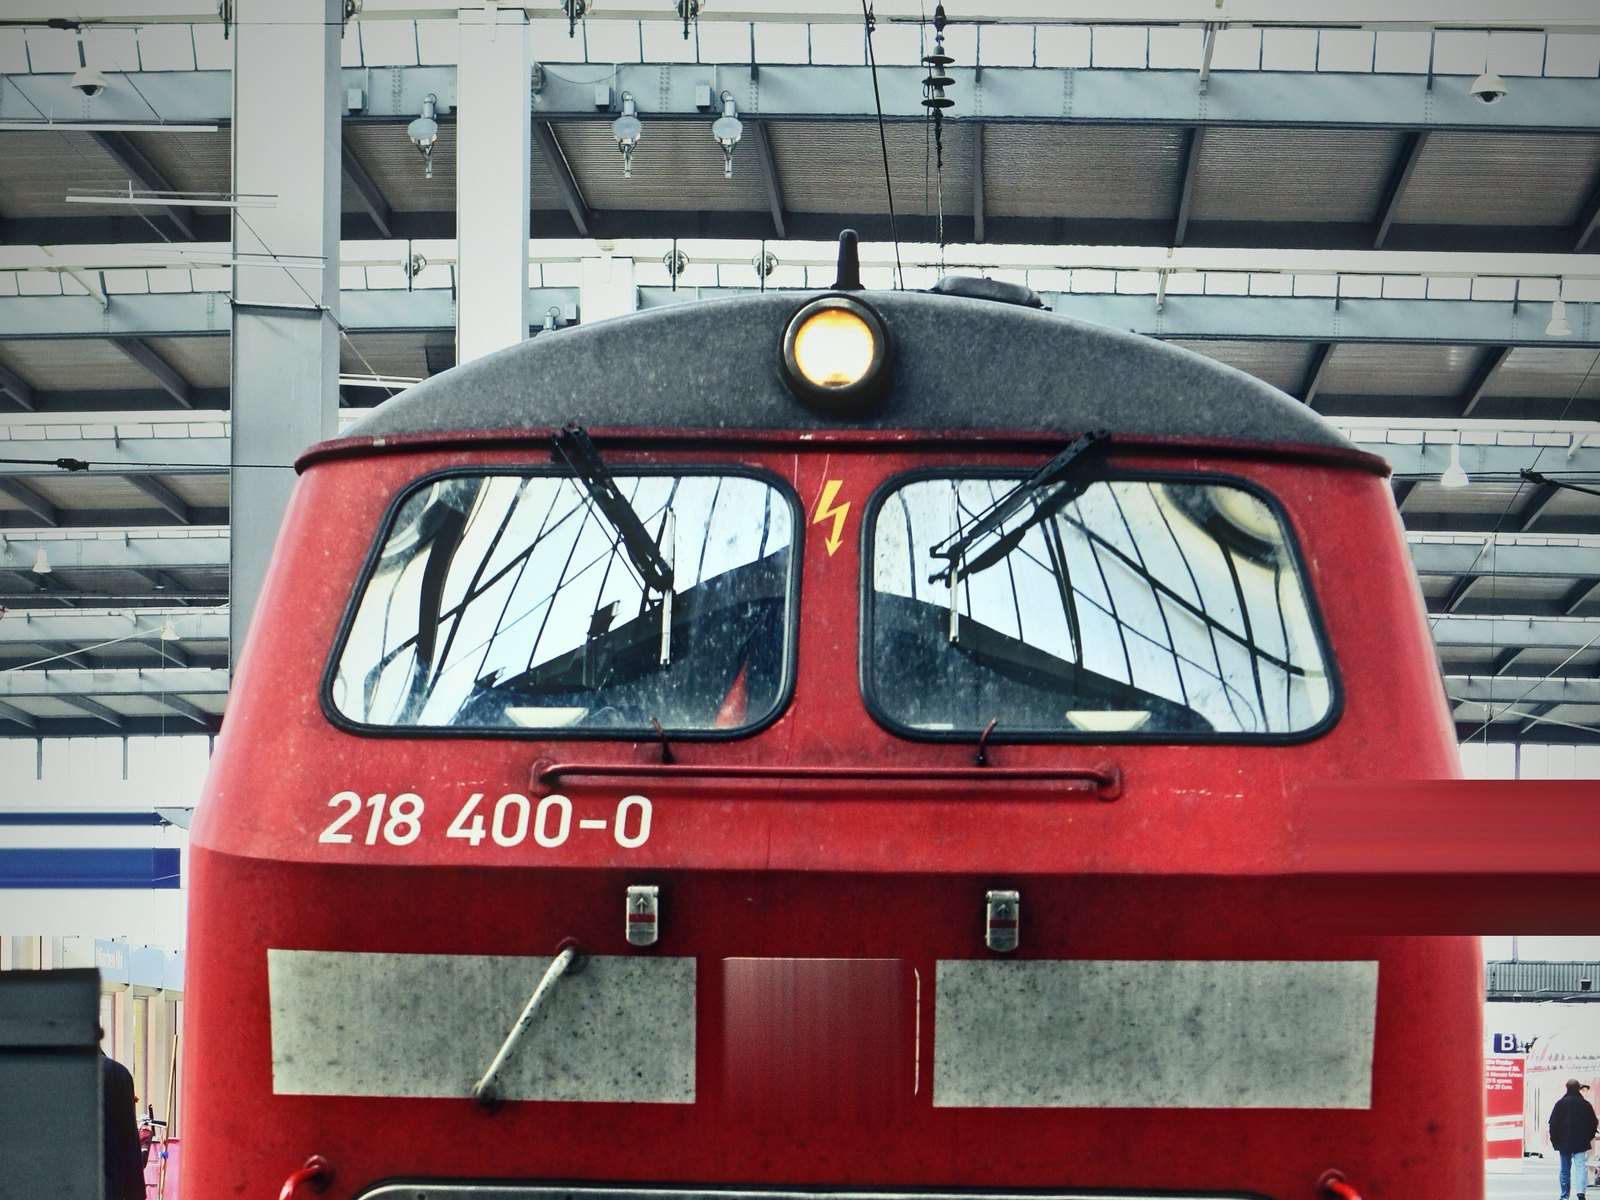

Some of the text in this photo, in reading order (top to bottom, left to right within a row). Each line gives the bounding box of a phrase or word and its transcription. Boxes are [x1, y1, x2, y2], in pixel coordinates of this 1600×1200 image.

[318, 791, 653, 849] 218 400-0
[1501, 1034, 1514, 1051] B
